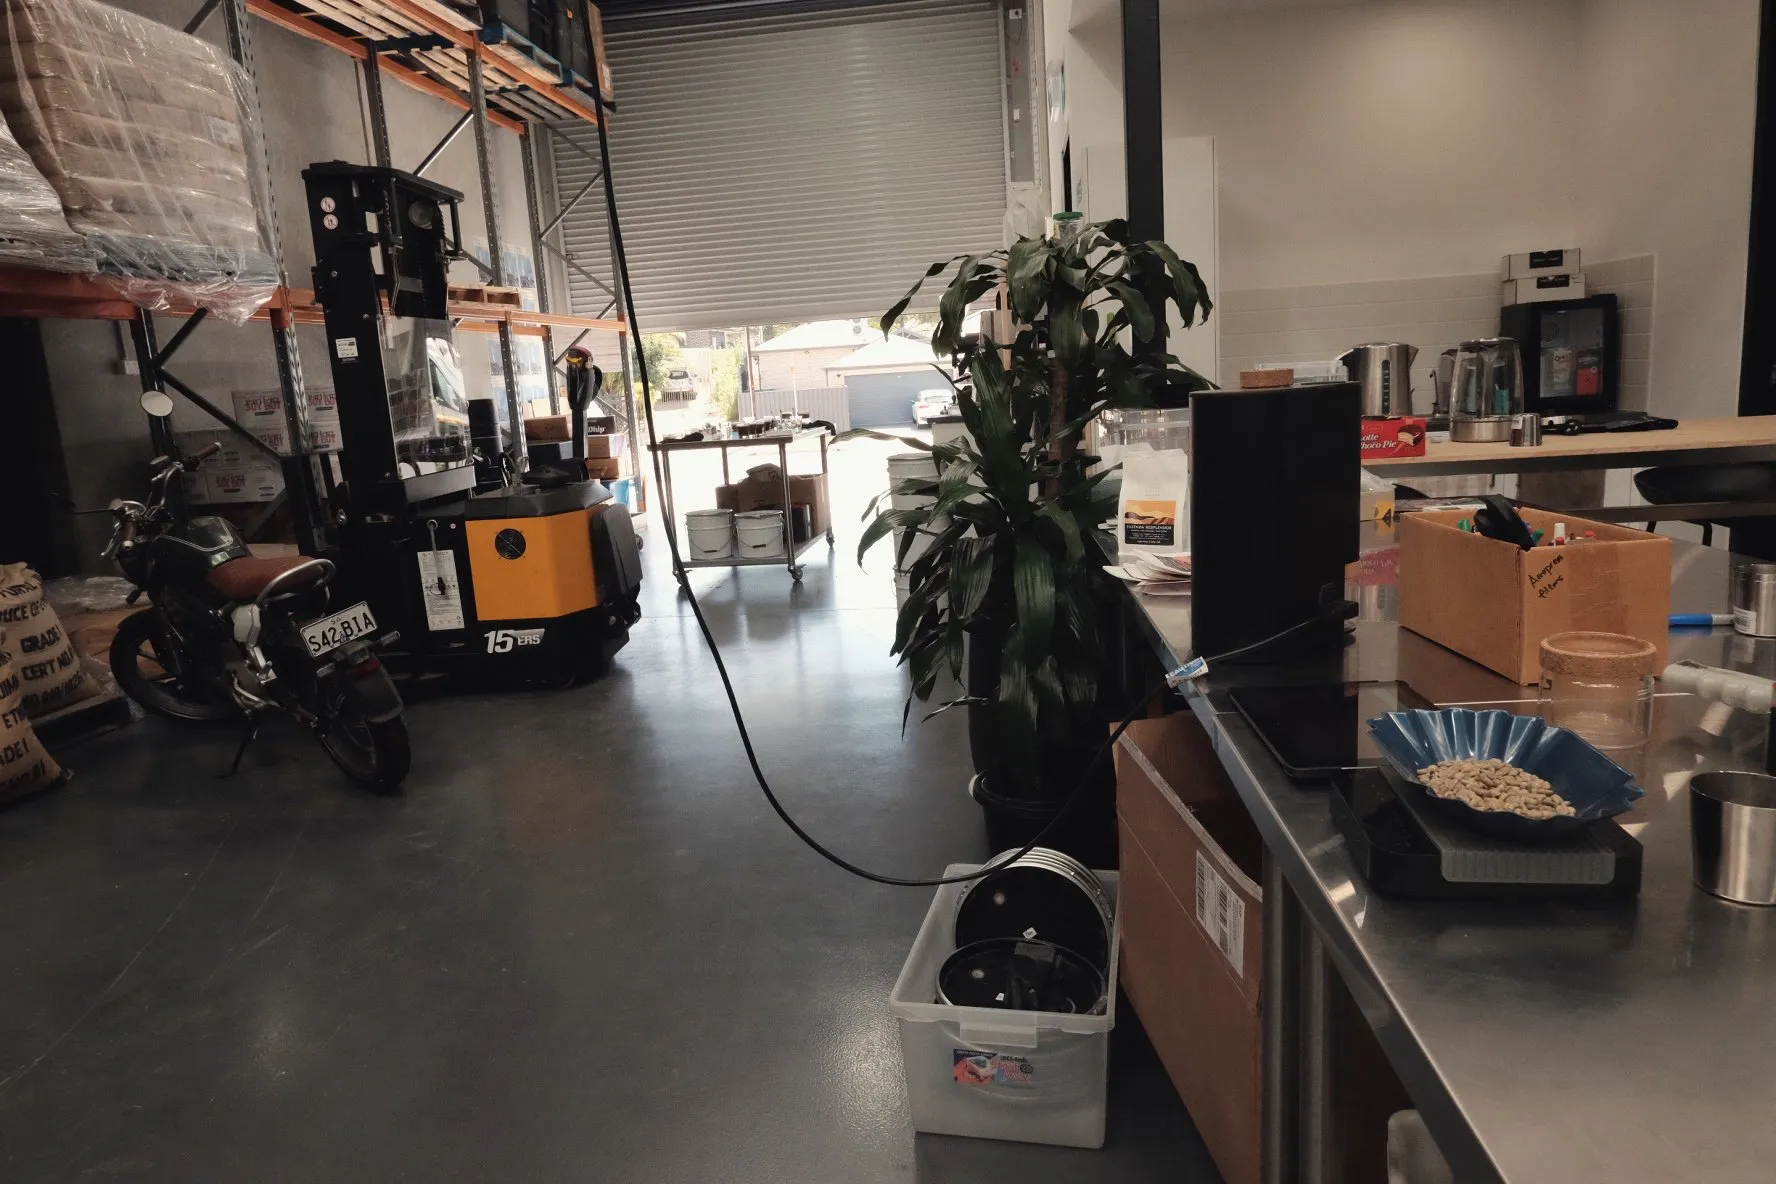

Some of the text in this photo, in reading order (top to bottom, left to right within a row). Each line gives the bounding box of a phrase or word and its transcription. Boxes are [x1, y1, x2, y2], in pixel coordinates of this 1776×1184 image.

[1361, 433, 1380, 442] otte
[1382, 440, 1397, 449] Pie
[484, 629, 541, 655] 15 ERS
[21, 659, 55, 681] CERT
